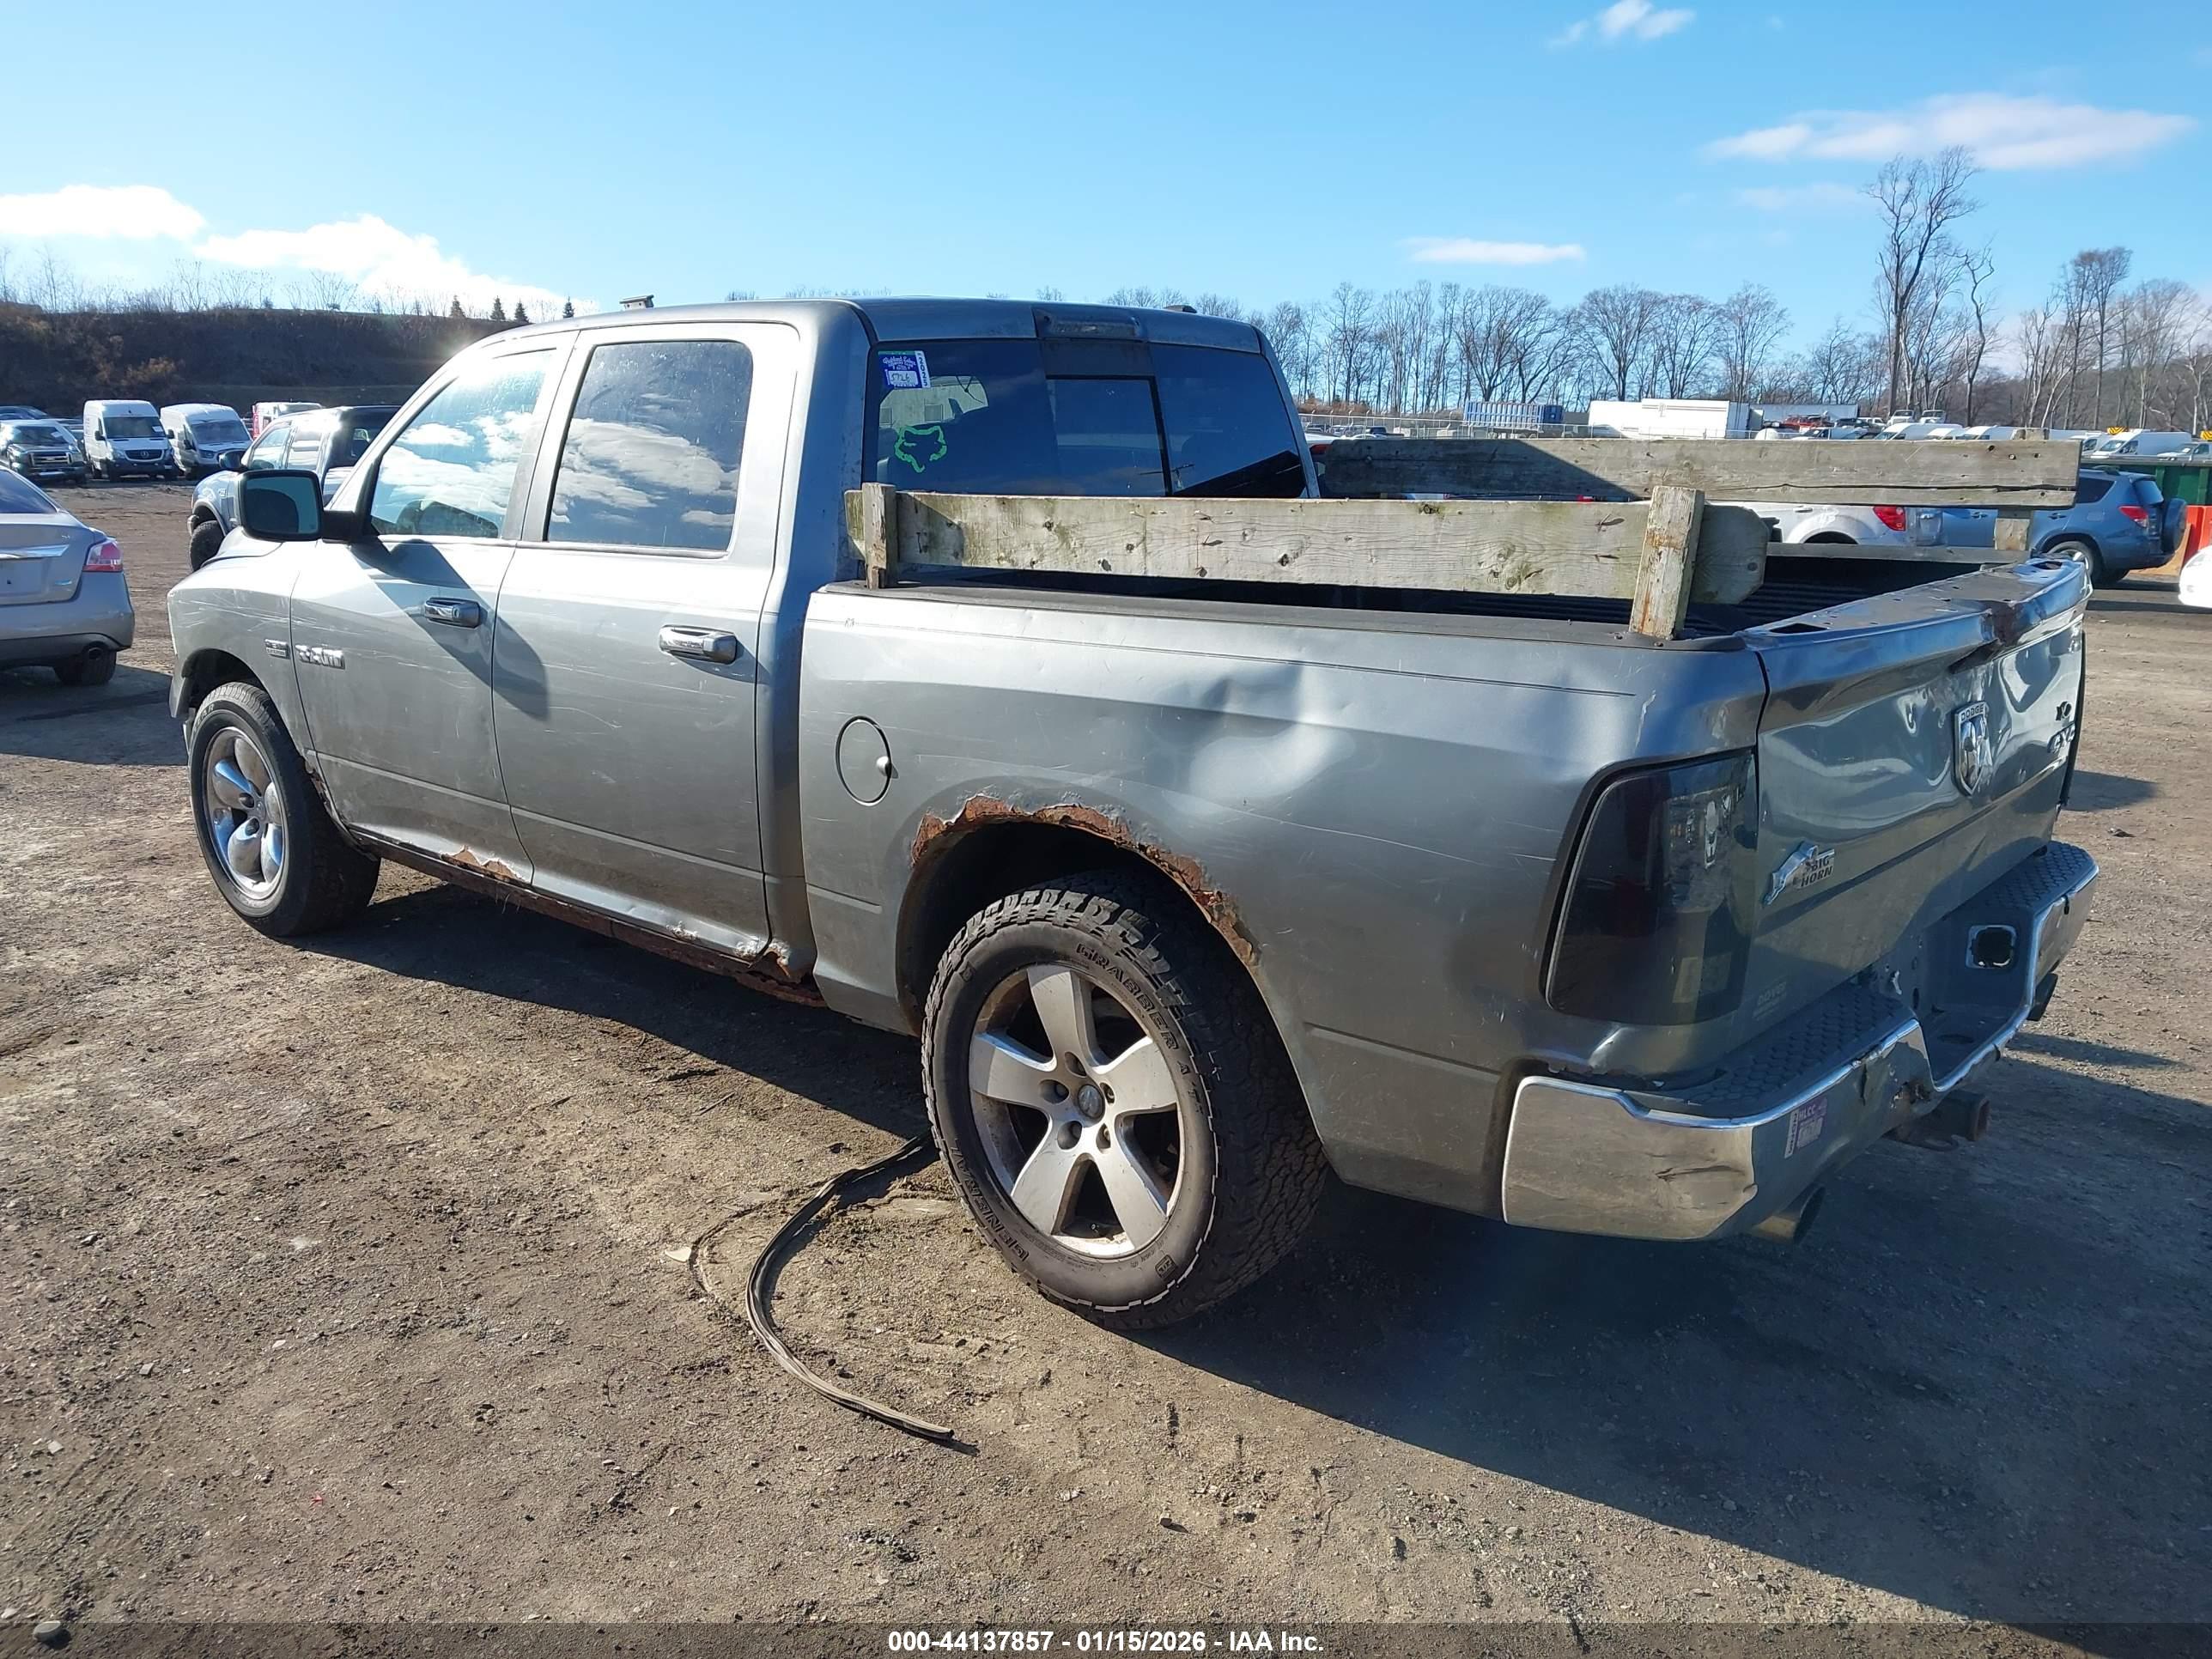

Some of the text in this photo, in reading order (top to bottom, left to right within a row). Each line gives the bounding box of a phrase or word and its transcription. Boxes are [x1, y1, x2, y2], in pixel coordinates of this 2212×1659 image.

[918, 356, 928, 386] 2025
[1960, 703, 1985, 721] DODGE
[1811, 854, 1830, 872] BIG
[1800, 866, 1833, 887] HORN
[1076, 942, 1180, 1051] GRABBER
[950, 1137, 1030, 1262] GENERAL
